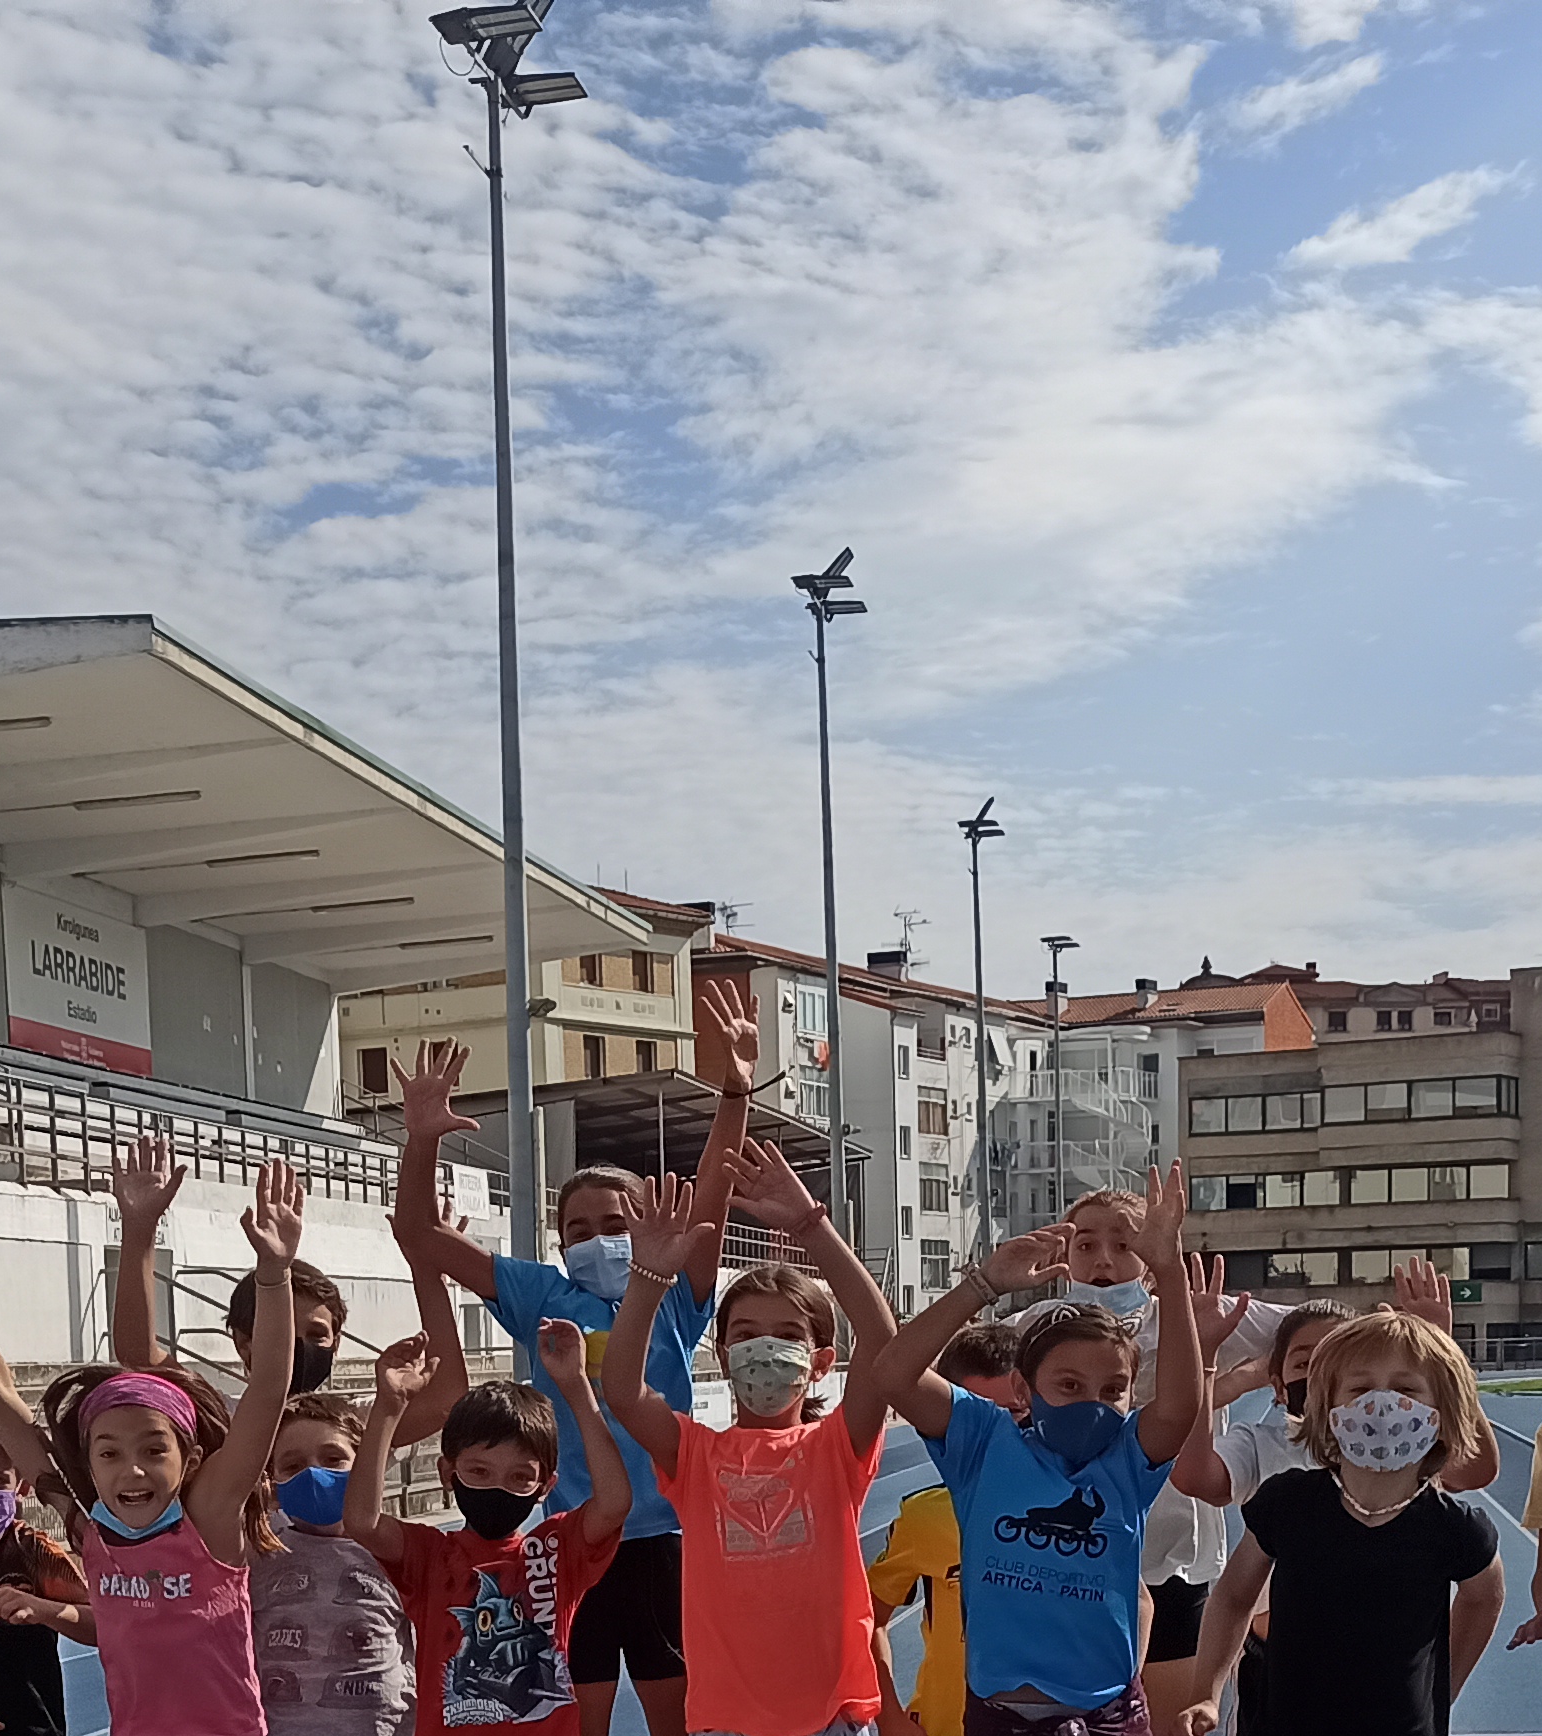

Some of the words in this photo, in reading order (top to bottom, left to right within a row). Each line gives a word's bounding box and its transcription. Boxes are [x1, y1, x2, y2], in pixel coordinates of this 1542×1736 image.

[56, 912, 100, 943] Kirolgunea
[30, 939, 127, 1001] LARRABIDE
[66, 999, 98, 1025] Estadio
[981, 1569, 1044, 1595] ARTICA
[1060, 1584, 1105, 1602] PATIN
[984, 1555, 1026, 1575] CLUB
[1027, 1563, 1107, 1588] DEPORTIVO
